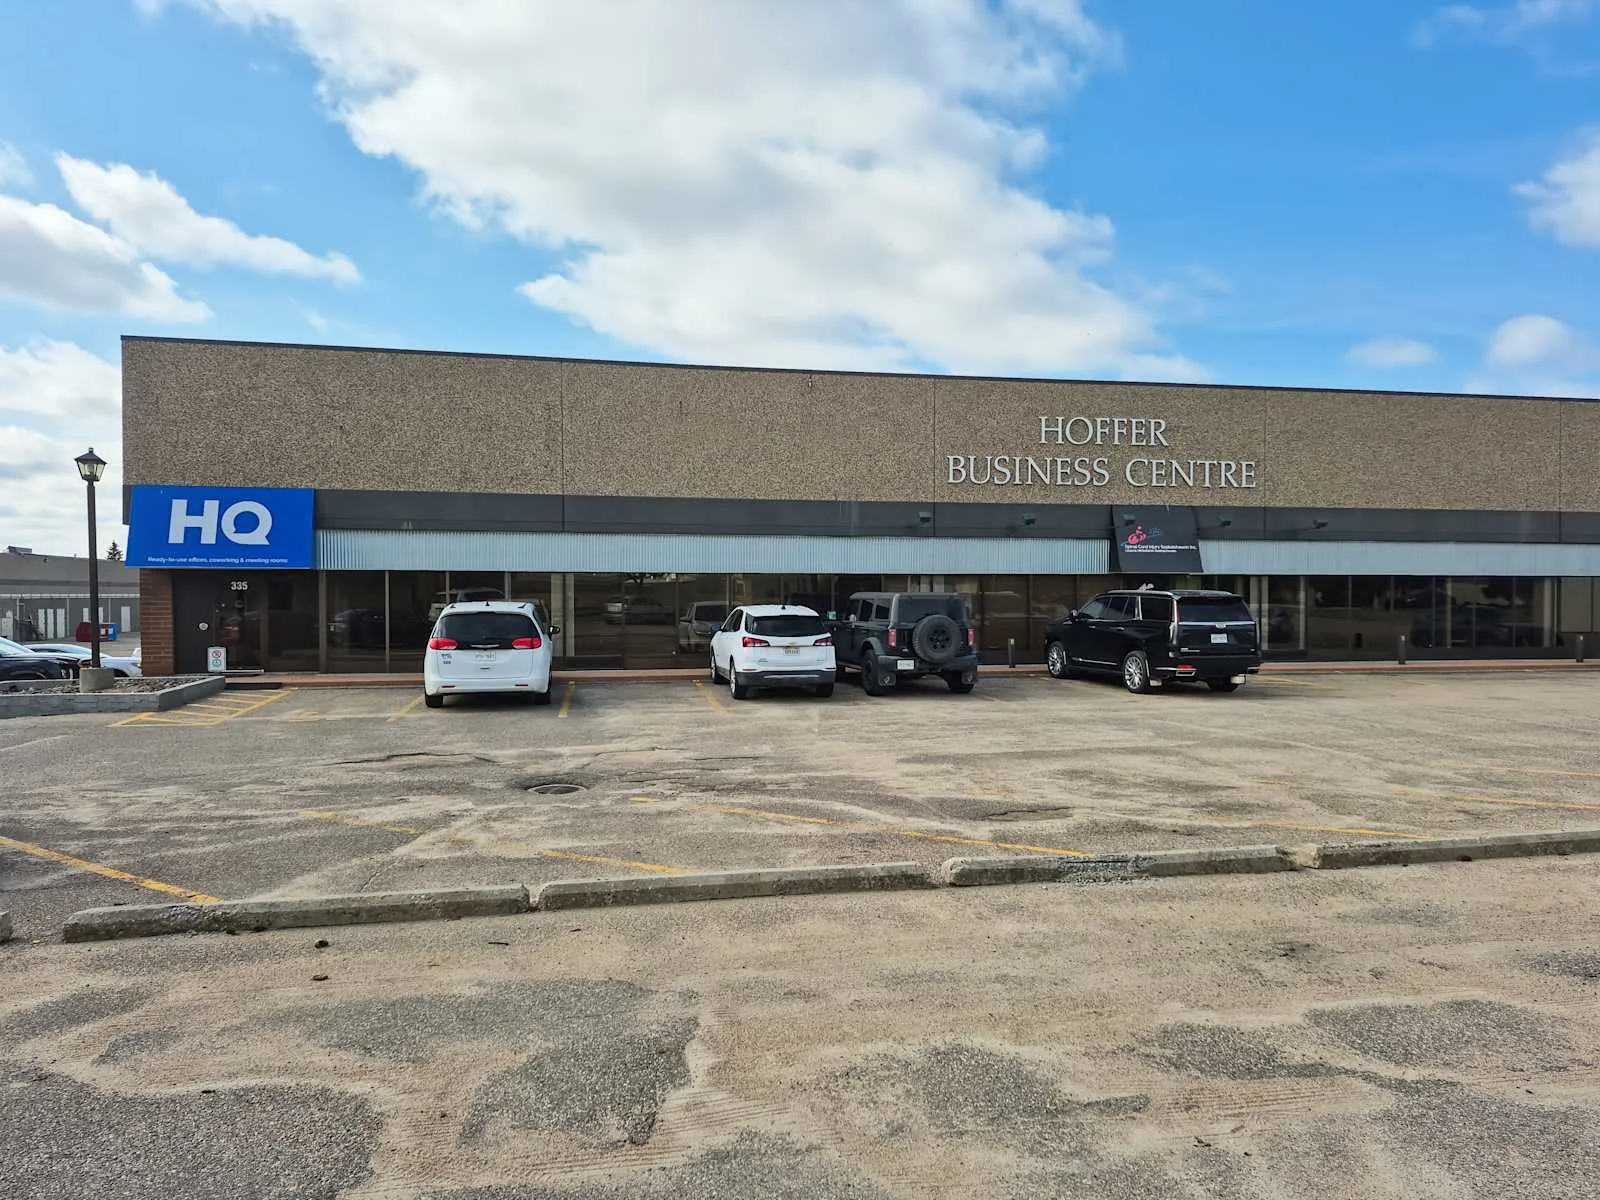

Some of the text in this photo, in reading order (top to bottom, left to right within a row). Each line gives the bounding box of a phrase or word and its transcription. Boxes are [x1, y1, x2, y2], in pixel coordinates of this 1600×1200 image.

[1039, 416, 1170, 447] HOFFER
[947, 456, 1257, 488] BUSINESS CENTRE
[168, 499, 273, 545] HQ
[147, 556, 187, 564] Ready-to-use
[231, 581, 248, 591] 335
